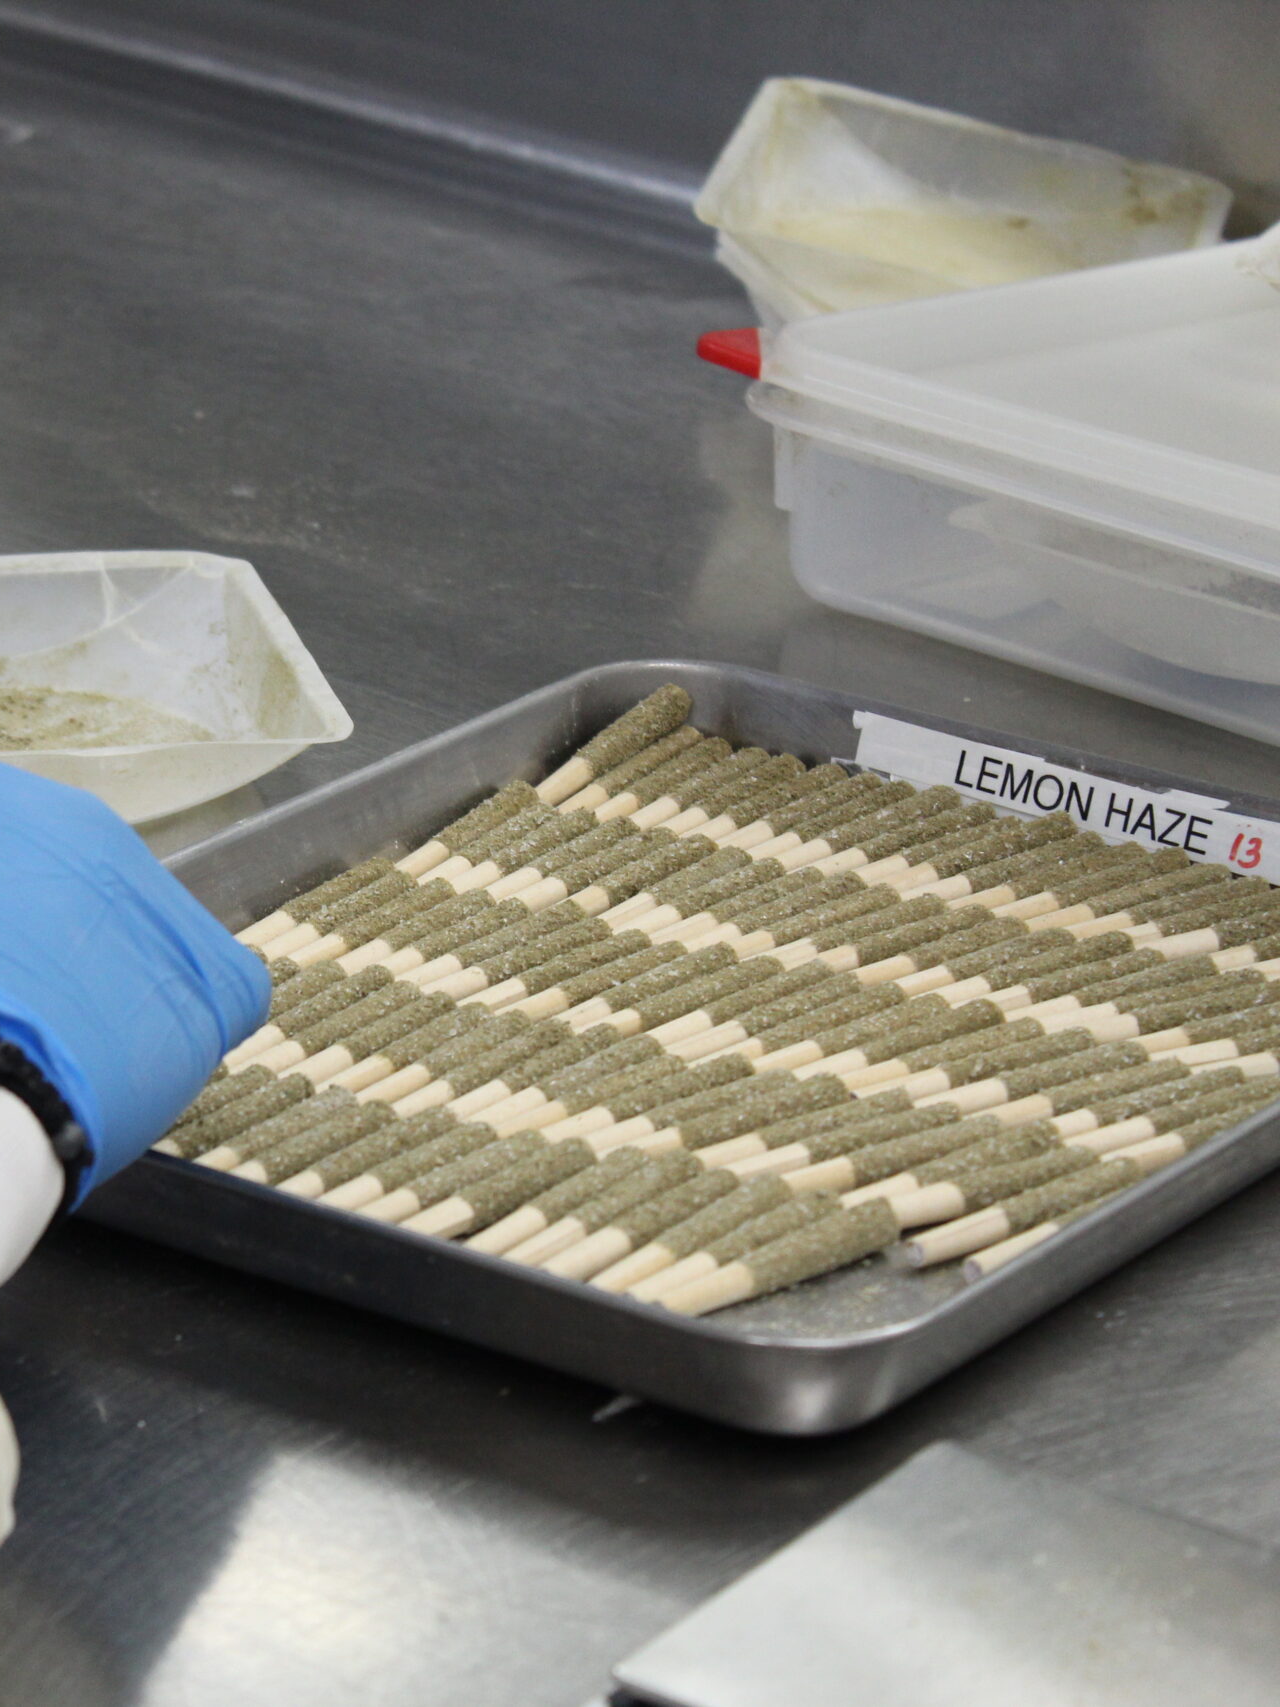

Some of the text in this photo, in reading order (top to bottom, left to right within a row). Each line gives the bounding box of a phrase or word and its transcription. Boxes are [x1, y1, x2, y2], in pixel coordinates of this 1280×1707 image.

[954, 750, 1213, 855] LEMON HAZE
[1228, 833, 1263, 869] 13
